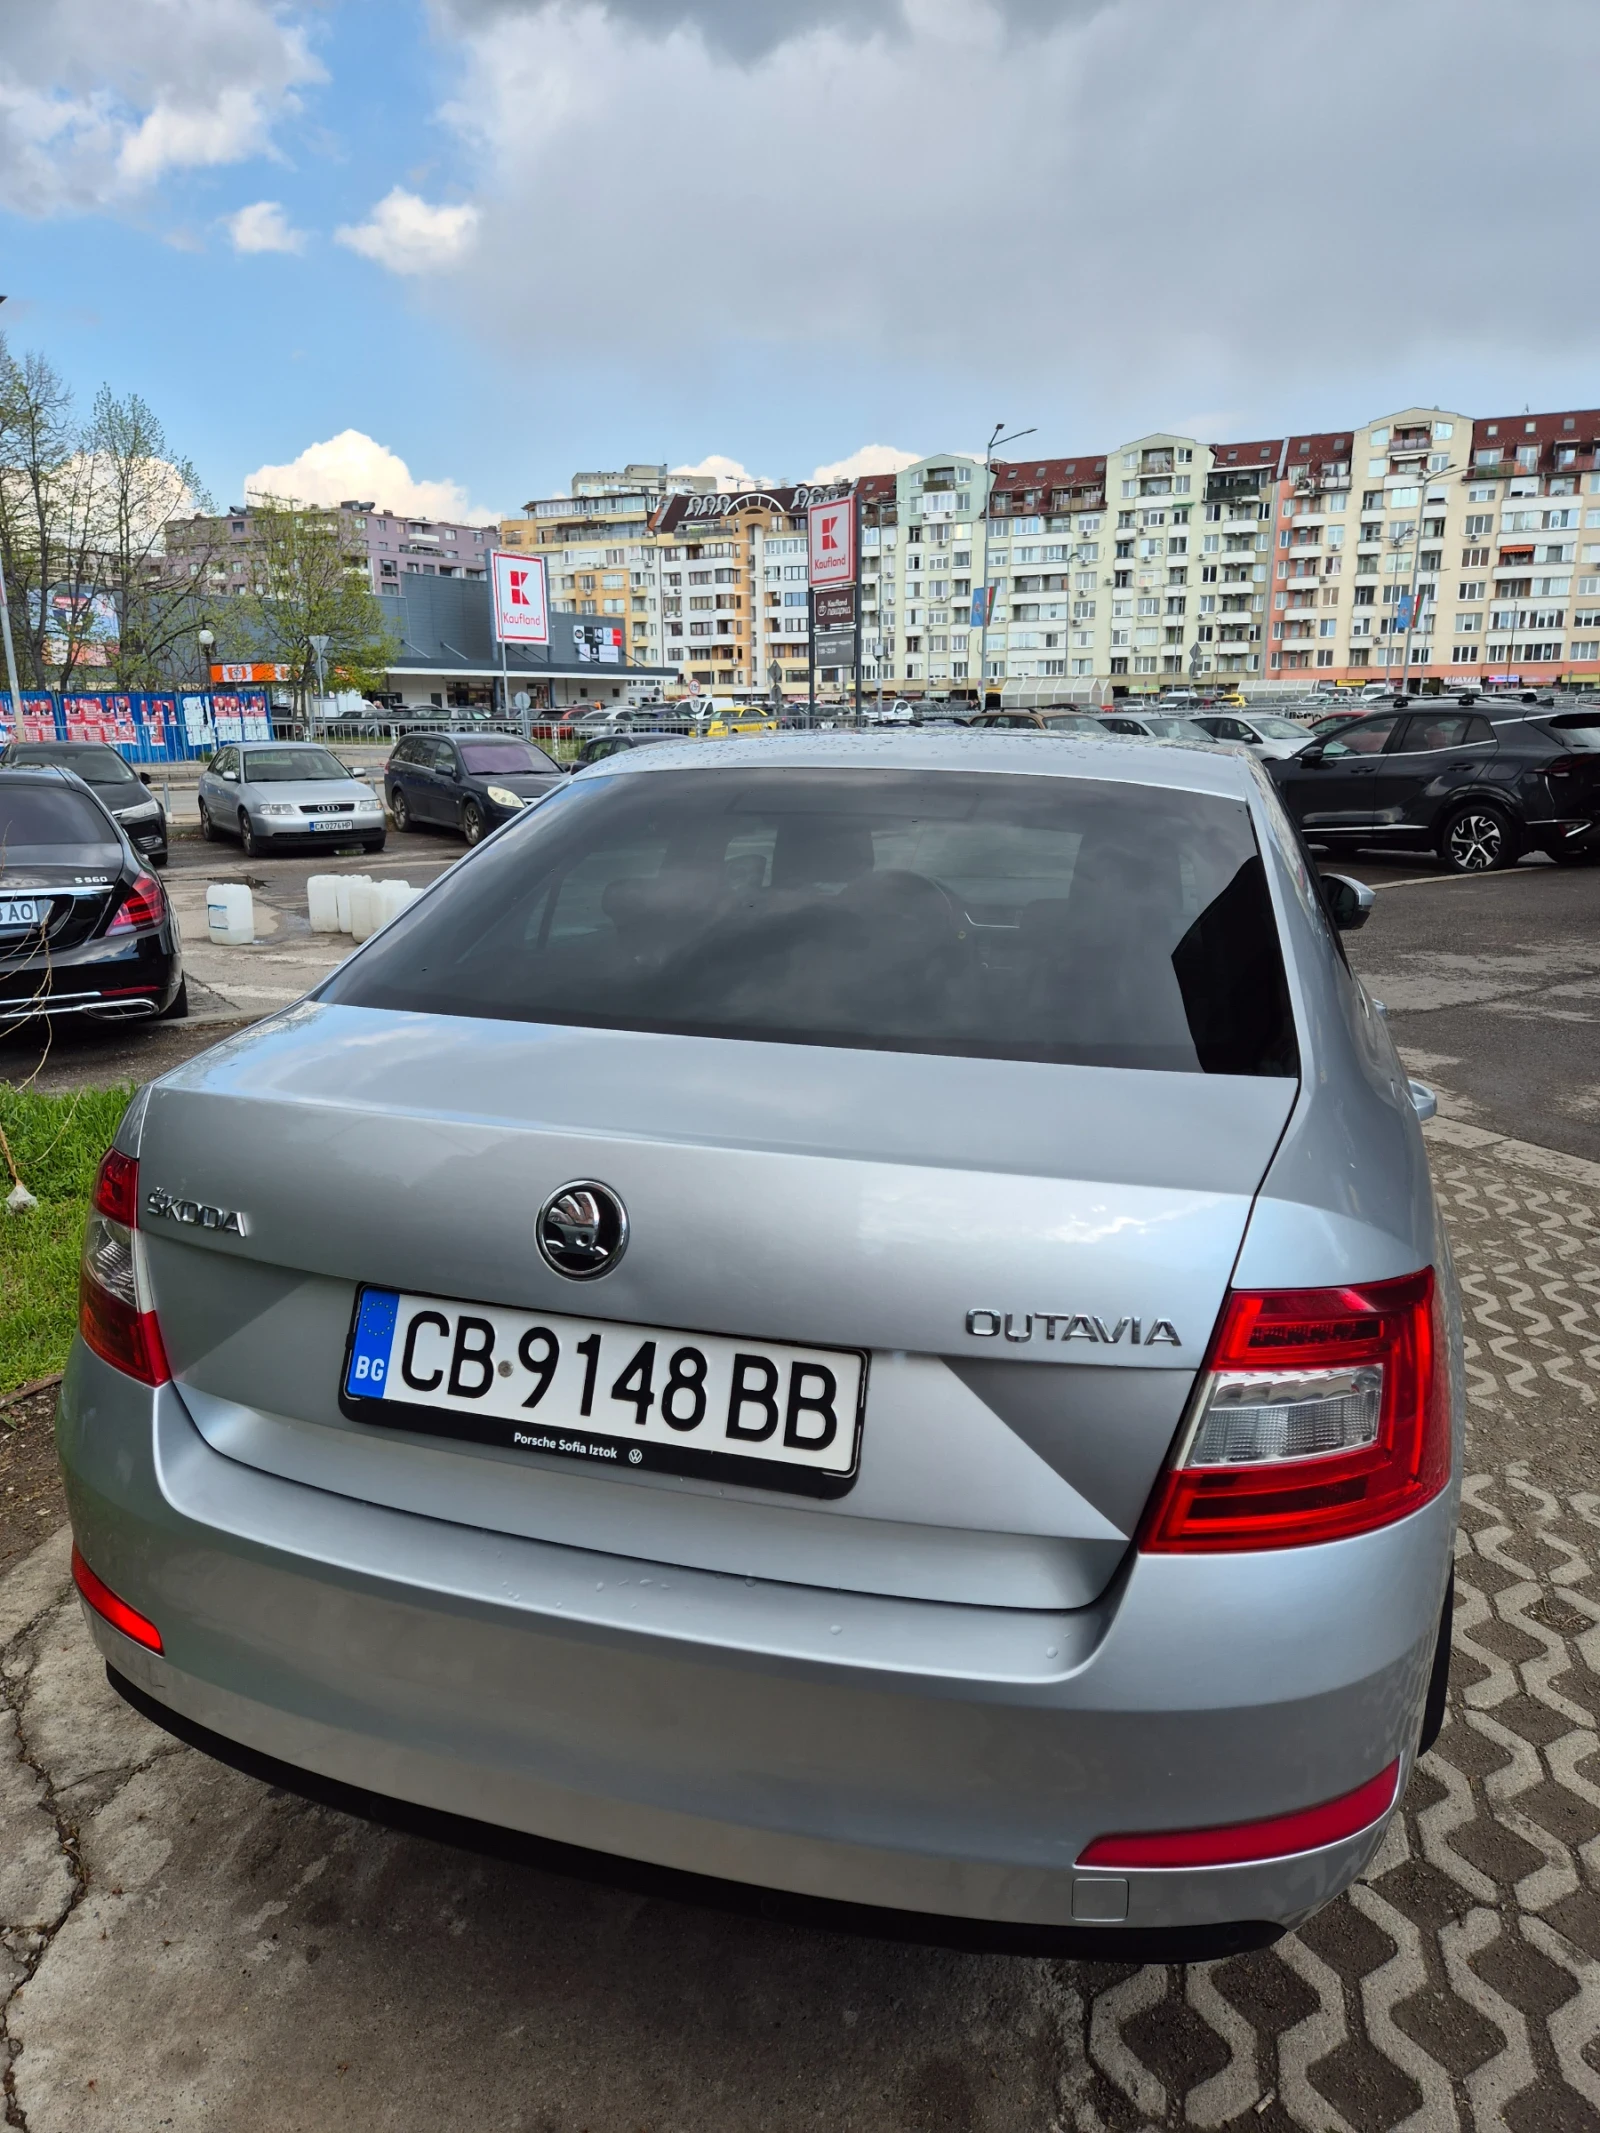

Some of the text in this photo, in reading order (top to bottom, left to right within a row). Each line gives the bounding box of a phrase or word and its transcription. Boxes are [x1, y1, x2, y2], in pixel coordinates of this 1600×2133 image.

[814, 554, 846, 570] Kaufland
[827, 598, 848, 608] Kaufland
[503, 611, 541, 626] Kaufland
[8, 903, 33, 921] AO
[965, 1308, 1183, 1347] OUTAVIA
[354, 1355, 386, 1382] BG
[401, 1310, 838, 1452] CB 9148 BB
[514, 1432, 618, 1459] Porsche Sofia Iztok
